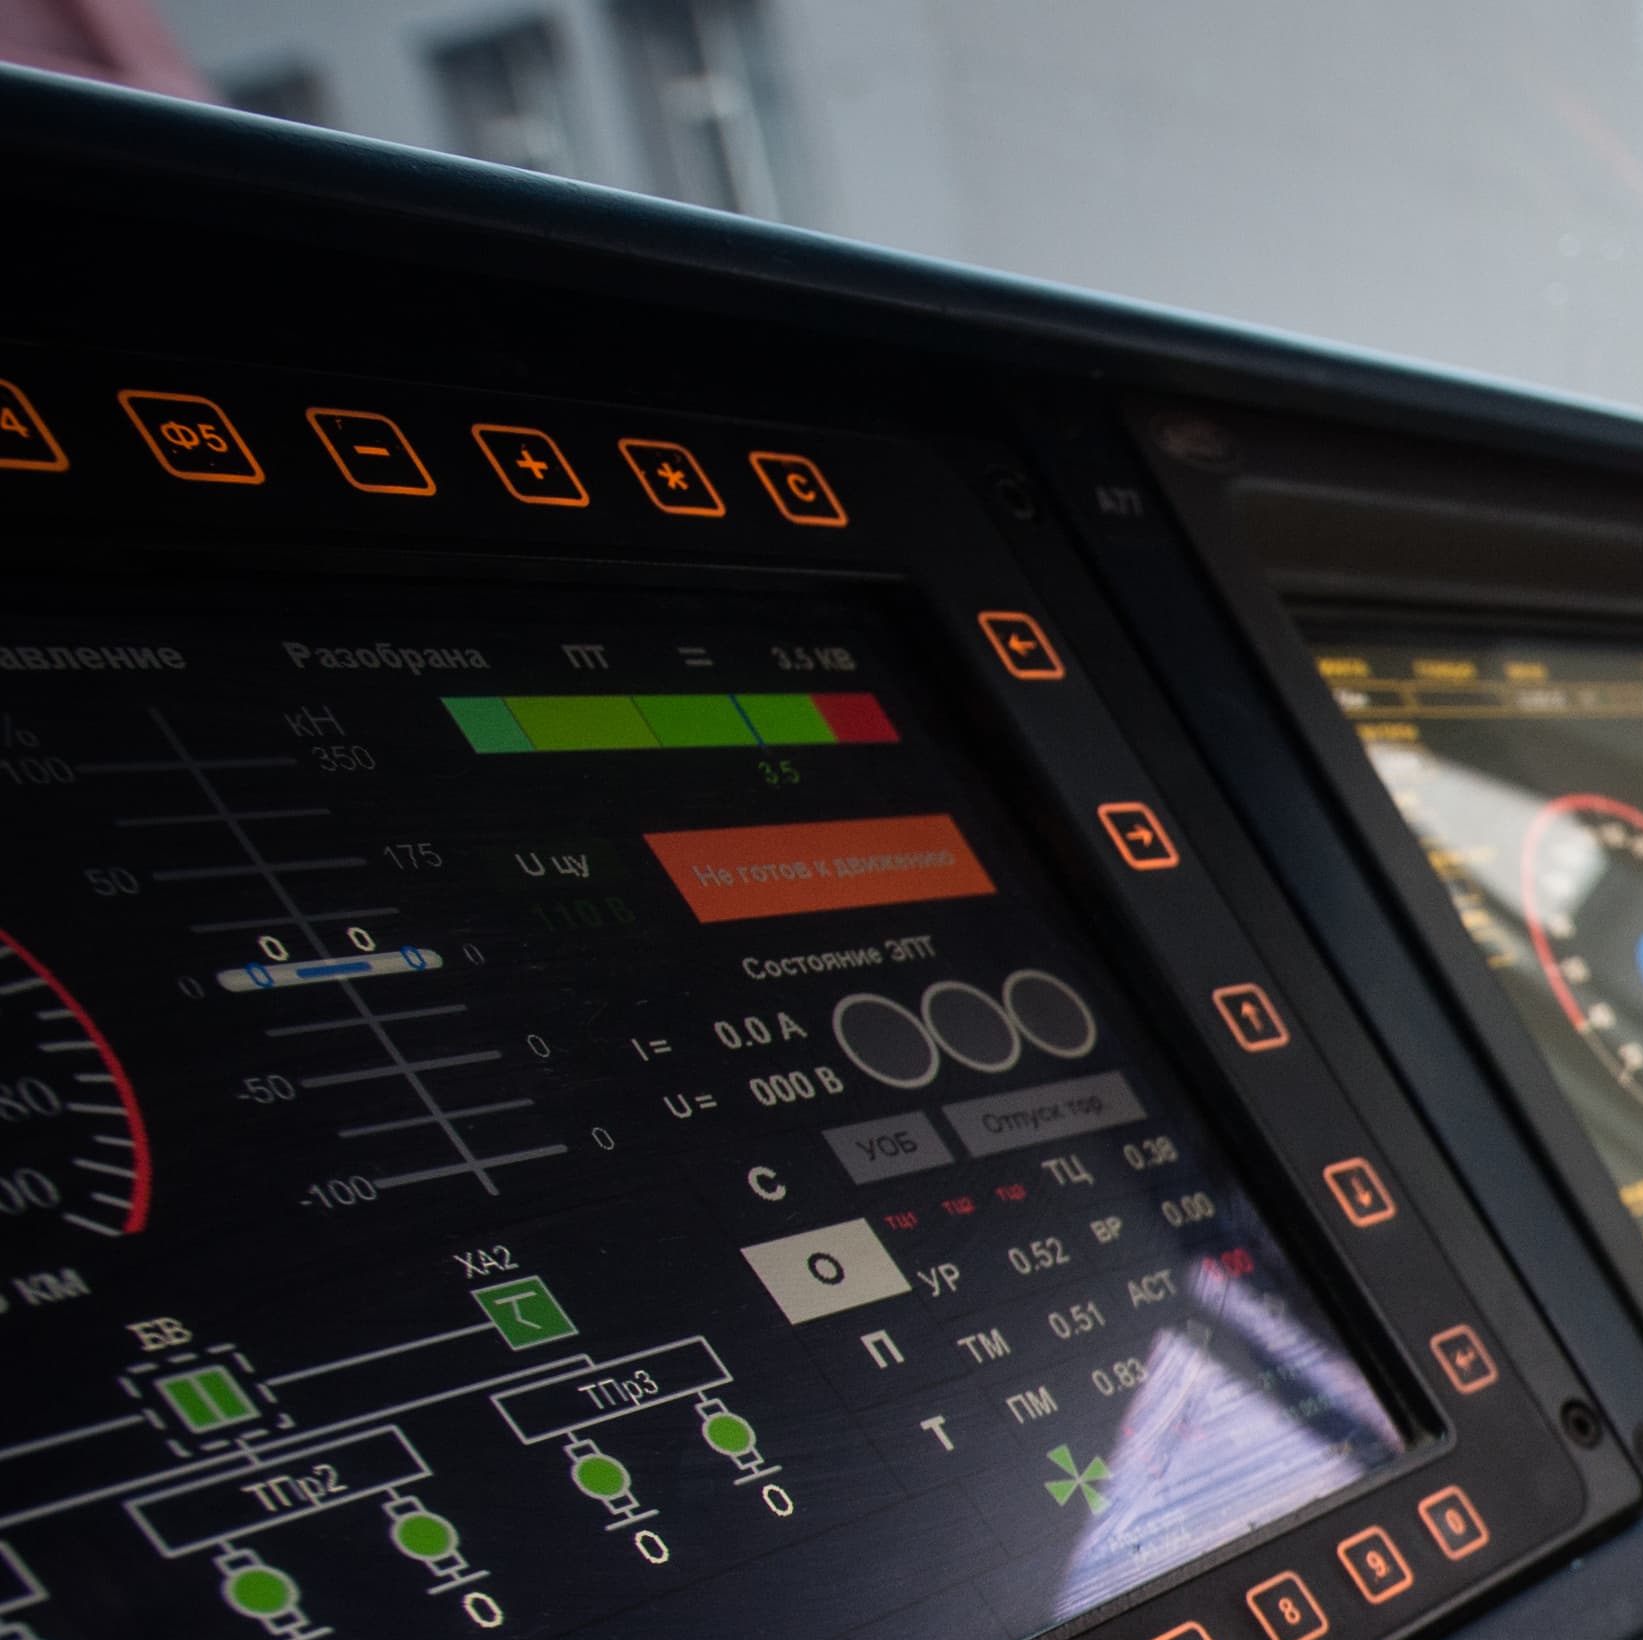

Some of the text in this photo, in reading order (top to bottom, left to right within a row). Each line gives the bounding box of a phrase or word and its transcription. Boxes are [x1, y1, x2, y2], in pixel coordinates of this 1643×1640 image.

[159, 419, 229, 455] Ф5
[282, 640, 491, 676] Разобрана
[560, 642, 609, 670] ПТ
[771, 645, 813, 671] 3.5
[283, 703, 348, 738] кН
[0, 756, 76, 786] 100
[311, 744, 377, 773] 350
[382, 841, 444, 870] 175
[83, 867, 140, 897] 50
[691, 862, 733, 889] Не
[736, 860, 811, 885] готов
[814, 860, 833, 880] к
[257, 933, 291, 963] 0
[346, 925, 377, 953] 0
[462, 942, 487, 967] 0
[740, 945, 884, 981] Состояние
[527, 1033, 552, 1059] 0
[713, 1013, 772, 1050] 0.0
[236, 1074, 298, 1105] -50
[749, 1068, 816, 1109] 000
[981, 1102, 1063, 1134] Отпуск
[591, 1125, 616, 1152] 0
[856, 1129, 919, 1162] УОБ
[1041, 1153, 1096, 1187] ТЦ
[300, 1174, 378, 1212] -100
[1160, 1190, 1217, 1230] 0.00
[915, 1236, 1072, 1299] УР 0.52
[1127, 1267, 1180, 1310] АСТ
[860, 1328, 906, 1371] П
[956, 1300, 1108, 1368] ТМ 0.51
[577, 1368, 660, 1412] ТПр3
[1005, 1358, 1147, 1426] ПМ 0.83
[920, 1414, 956, 1452] Т
[240, 1461, 349, 1514] ТПр2
[762, 1483, 795, 1517] 0
[1445, 1507, 1467, 1537] 0
[634, 1528, 671, 1565] 0
[1365, 1550, 1389, 1580] 9
[462, 1591, 505, 1629] 0
[1277, 1596, 1301, 1626] 8
